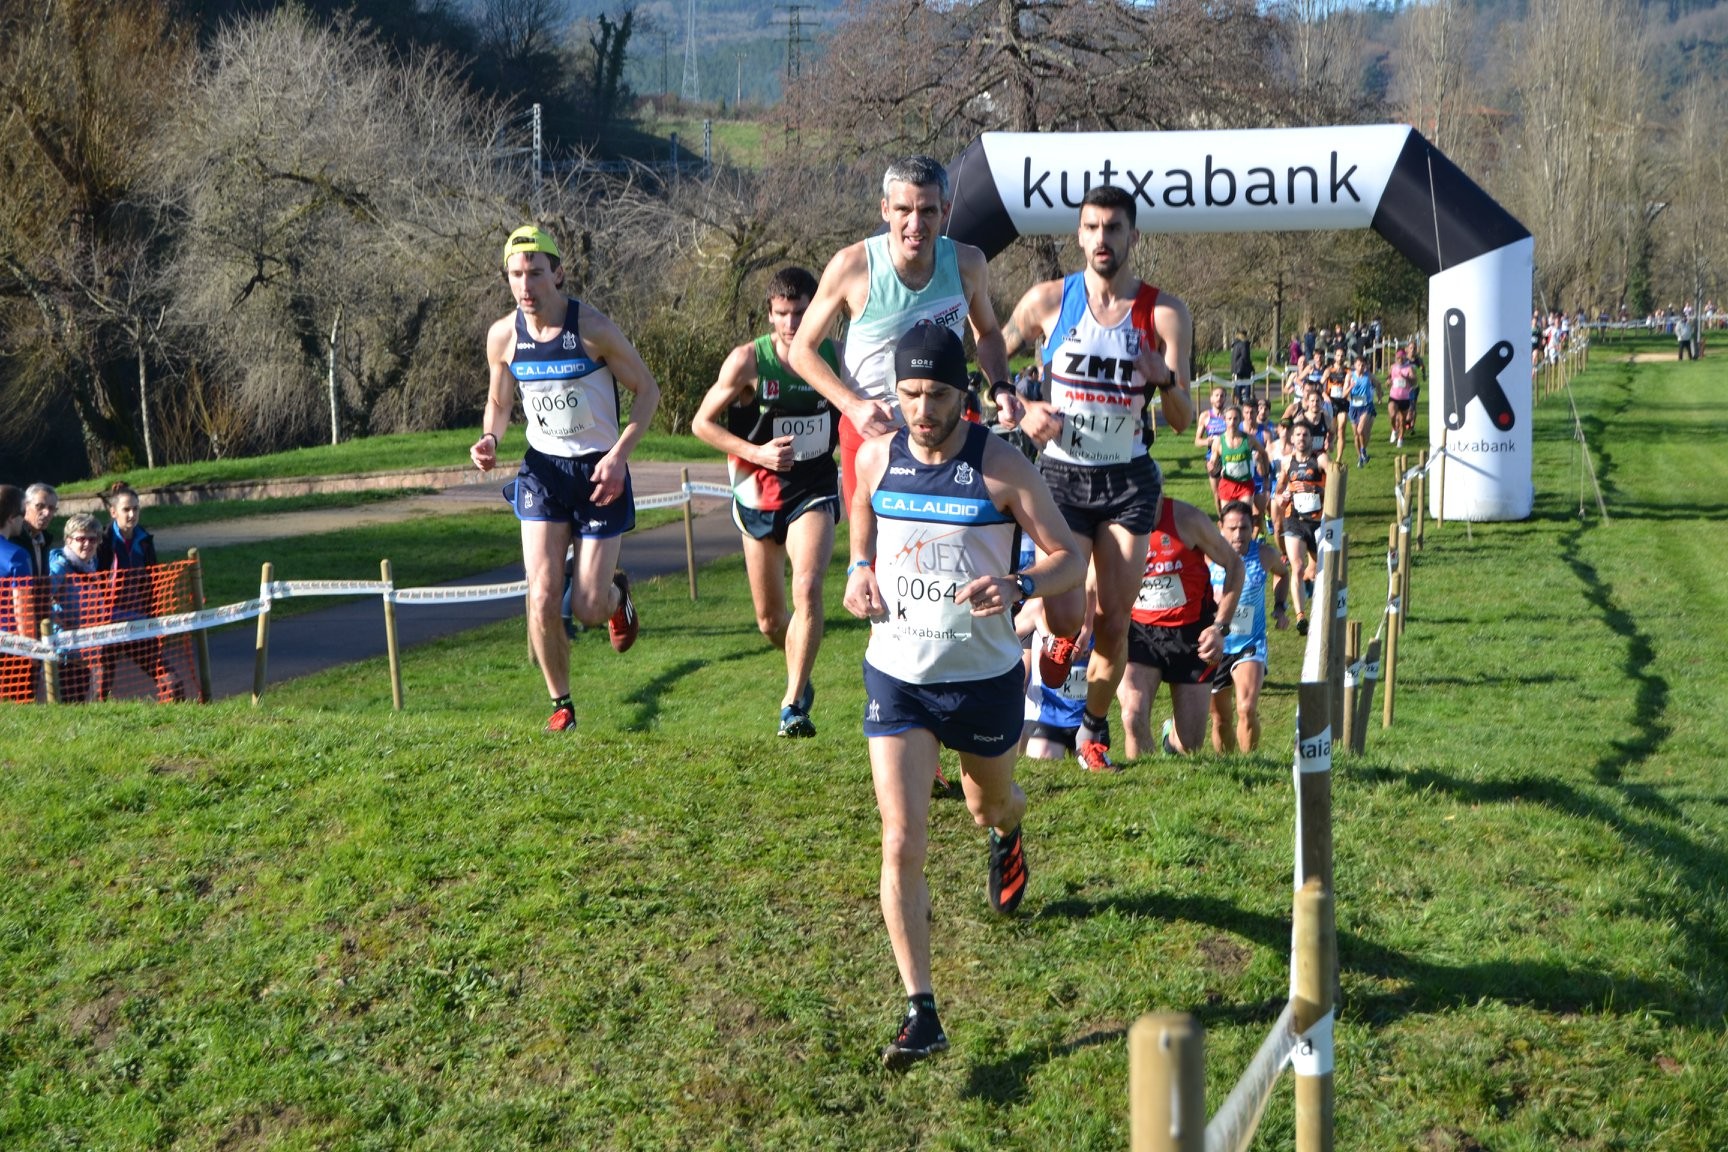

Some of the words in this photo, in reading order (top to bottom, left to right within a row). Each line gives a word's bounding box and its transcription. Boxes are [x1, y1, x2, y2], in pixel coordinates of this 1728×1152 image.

[1023, 150, 1362, 208] kutxabank
[935, 308, 959, 326] BAT
[516, 362, 586, 377] C.A.LAUDIO
[911, 358, 934, 366] GORE
[1065, 352, 1135, 382] ZMT
[531, 391, 579, 412] 0066
[1065, 390, 1132, 407] ANDOAIN
[781, 417, 824, 436] 0051
[1073, 413, 1126, 434] 0117
[1447, 439, 1516, 453] utxabank
[882, 497, 980, 517] C.A.LAUDIO
[896, 575, 959, 603] 0064
